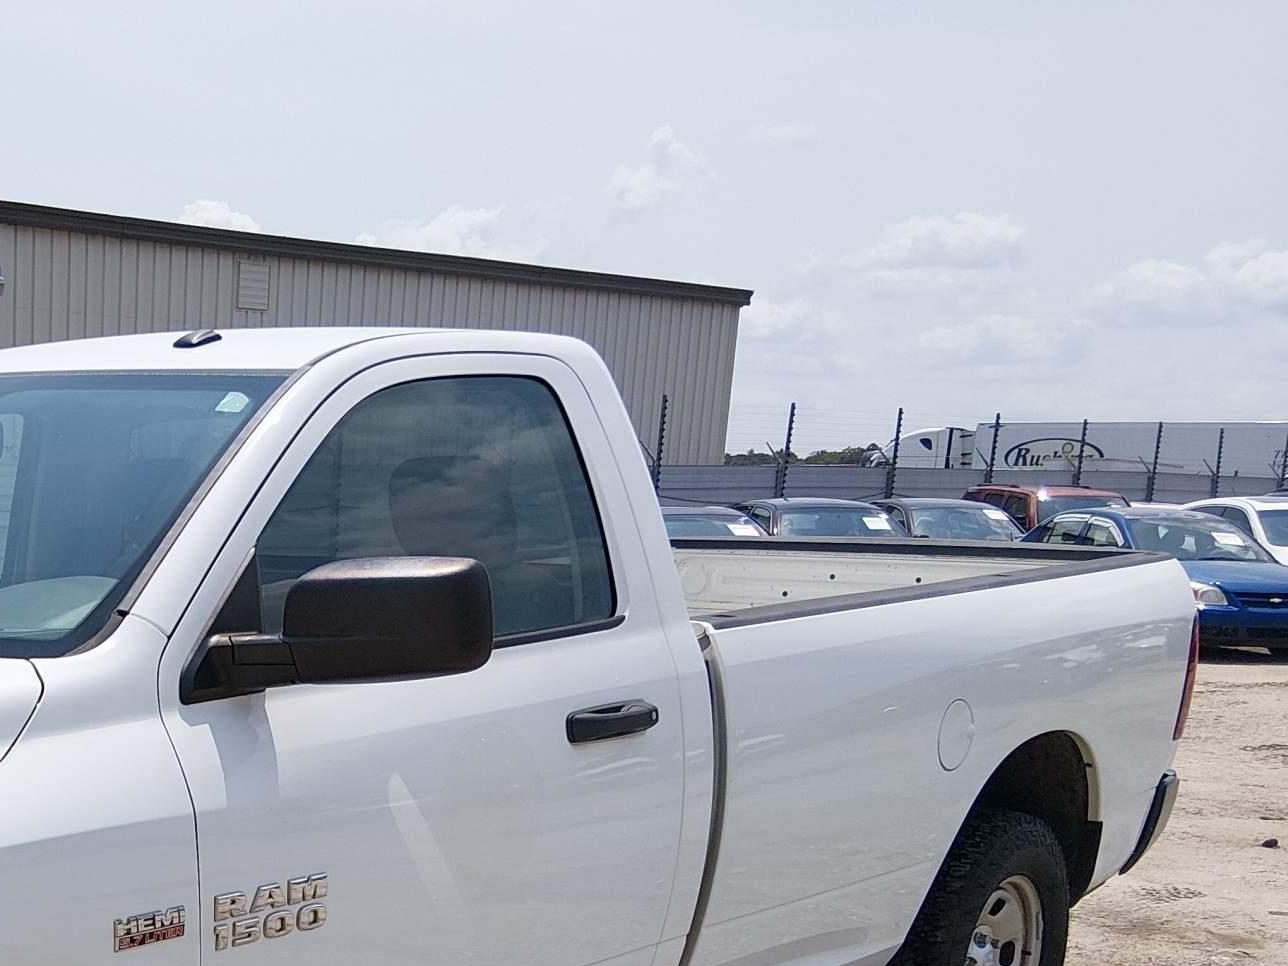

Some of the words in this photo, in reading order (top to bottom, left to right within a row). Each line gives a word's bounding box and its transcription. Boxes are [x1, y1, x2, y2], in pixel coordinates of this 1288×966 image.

[113, 904, 186, 938] HEMI
[214, 871, 328, 922] RAM
[214, 902, 328, 952] 1500
